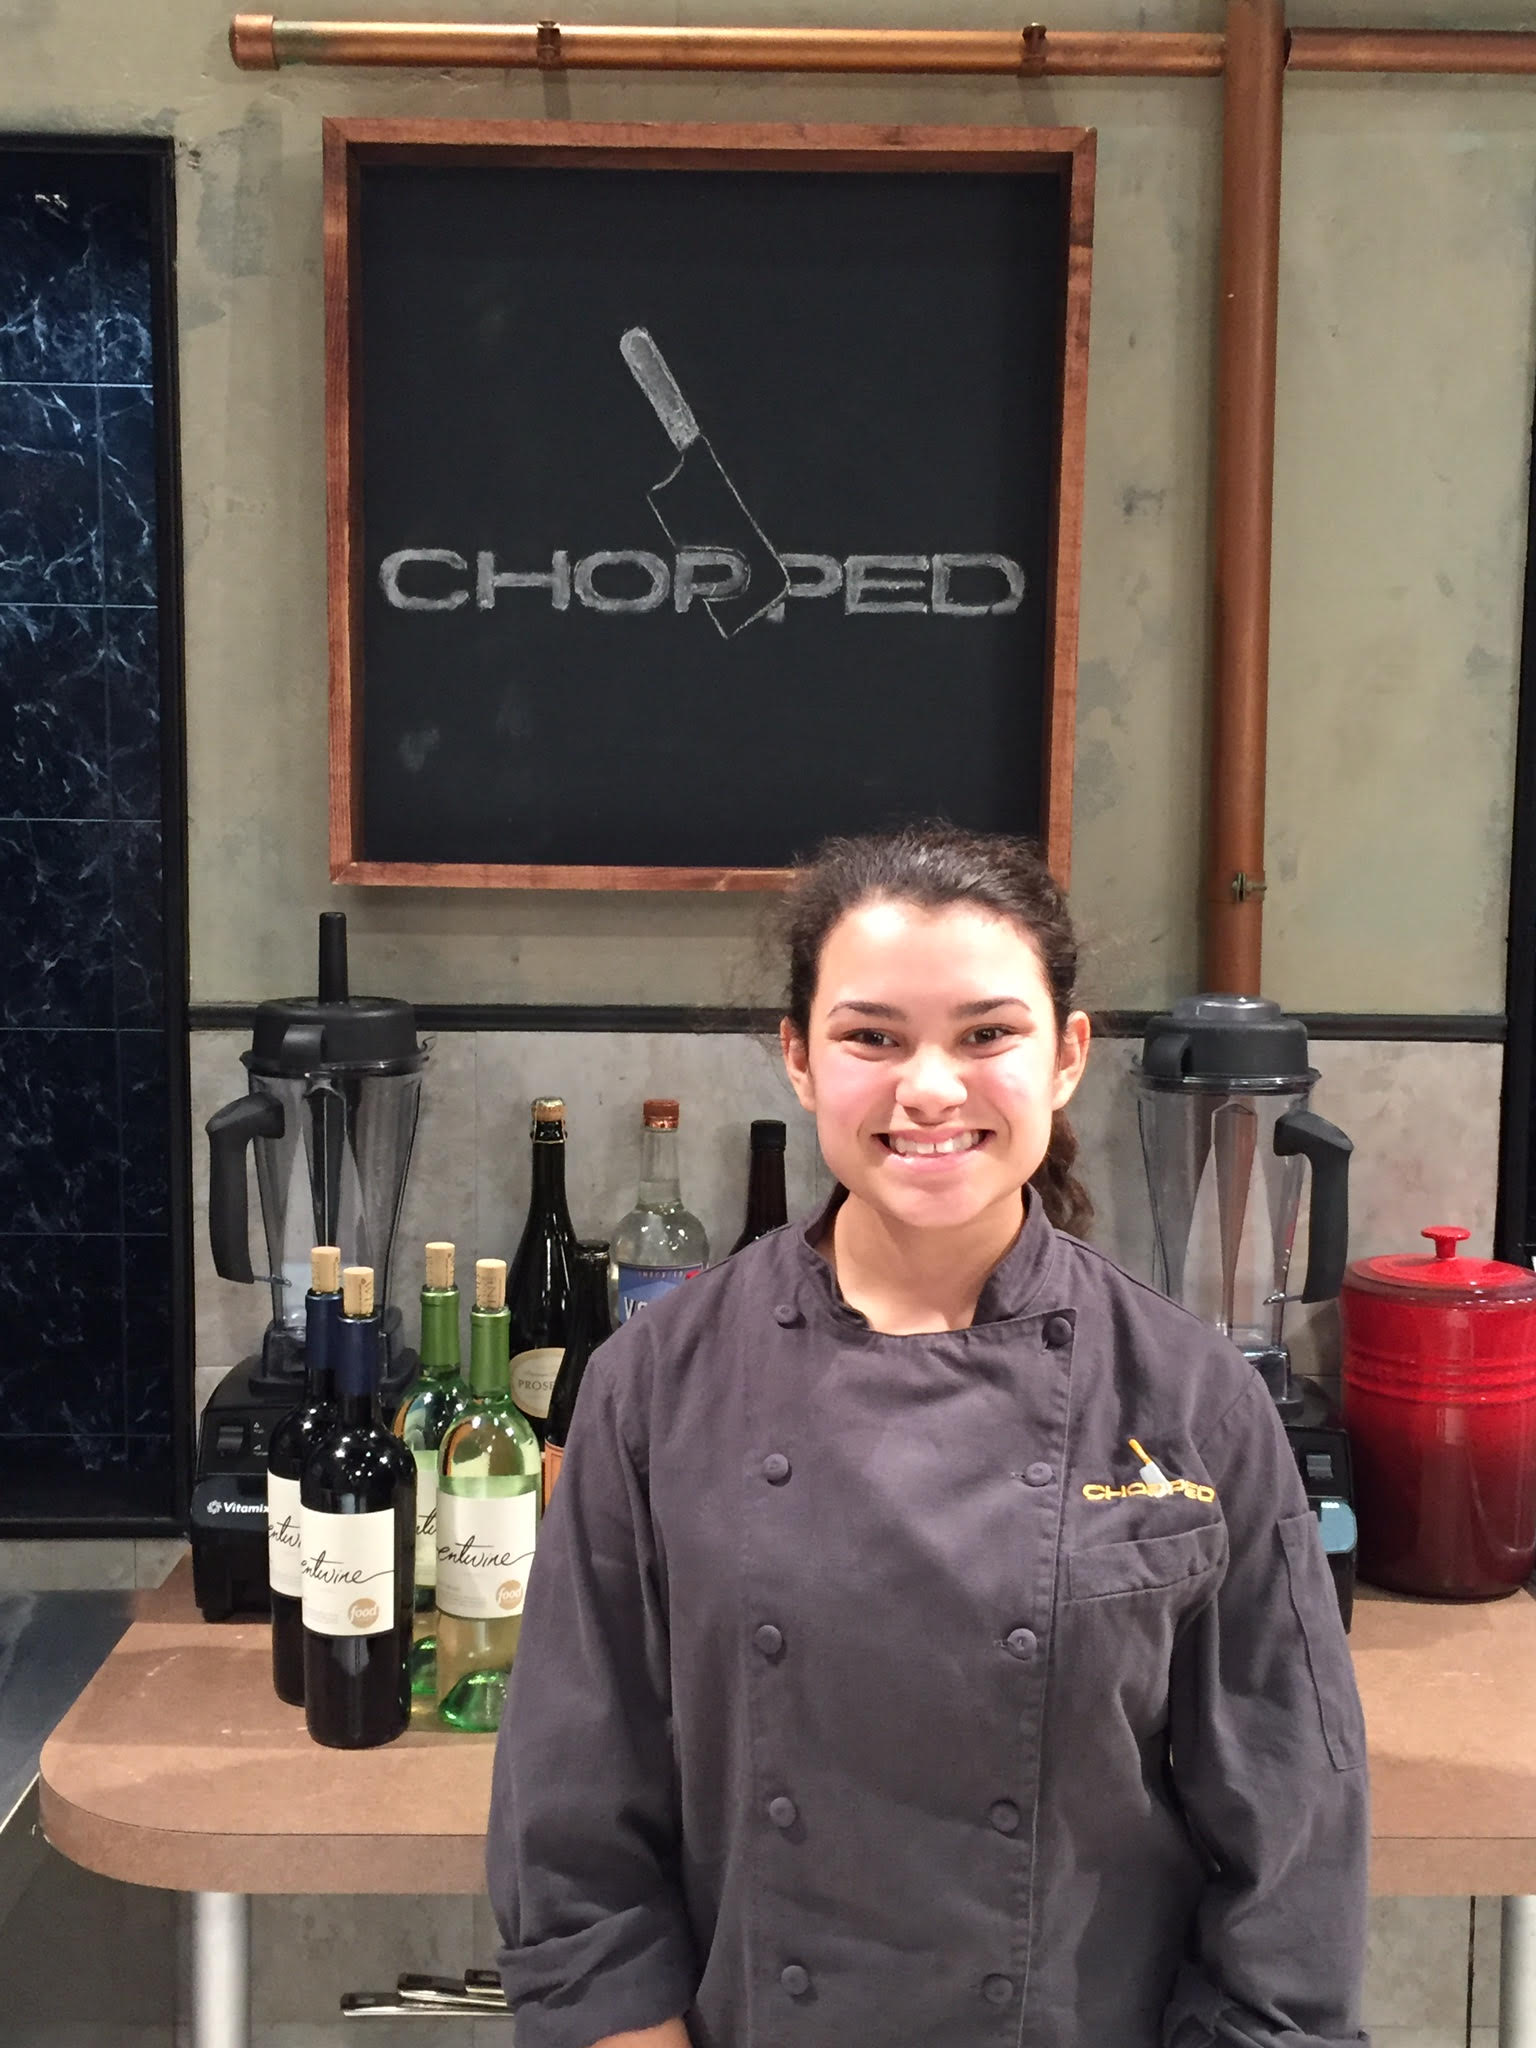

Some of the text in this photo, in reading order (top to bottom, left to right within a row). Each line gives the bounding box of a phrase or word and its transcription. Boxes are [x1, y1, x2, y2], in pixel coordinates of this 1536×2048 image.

[378, 546, 1026, 621] CHOPPED
[223, 1501, 269, 1513] Vitamix
[436, 1535, 535, 1568] entwine
[498, 1587, 522, 1602] food
[349, 1606, 379, 1621] food
